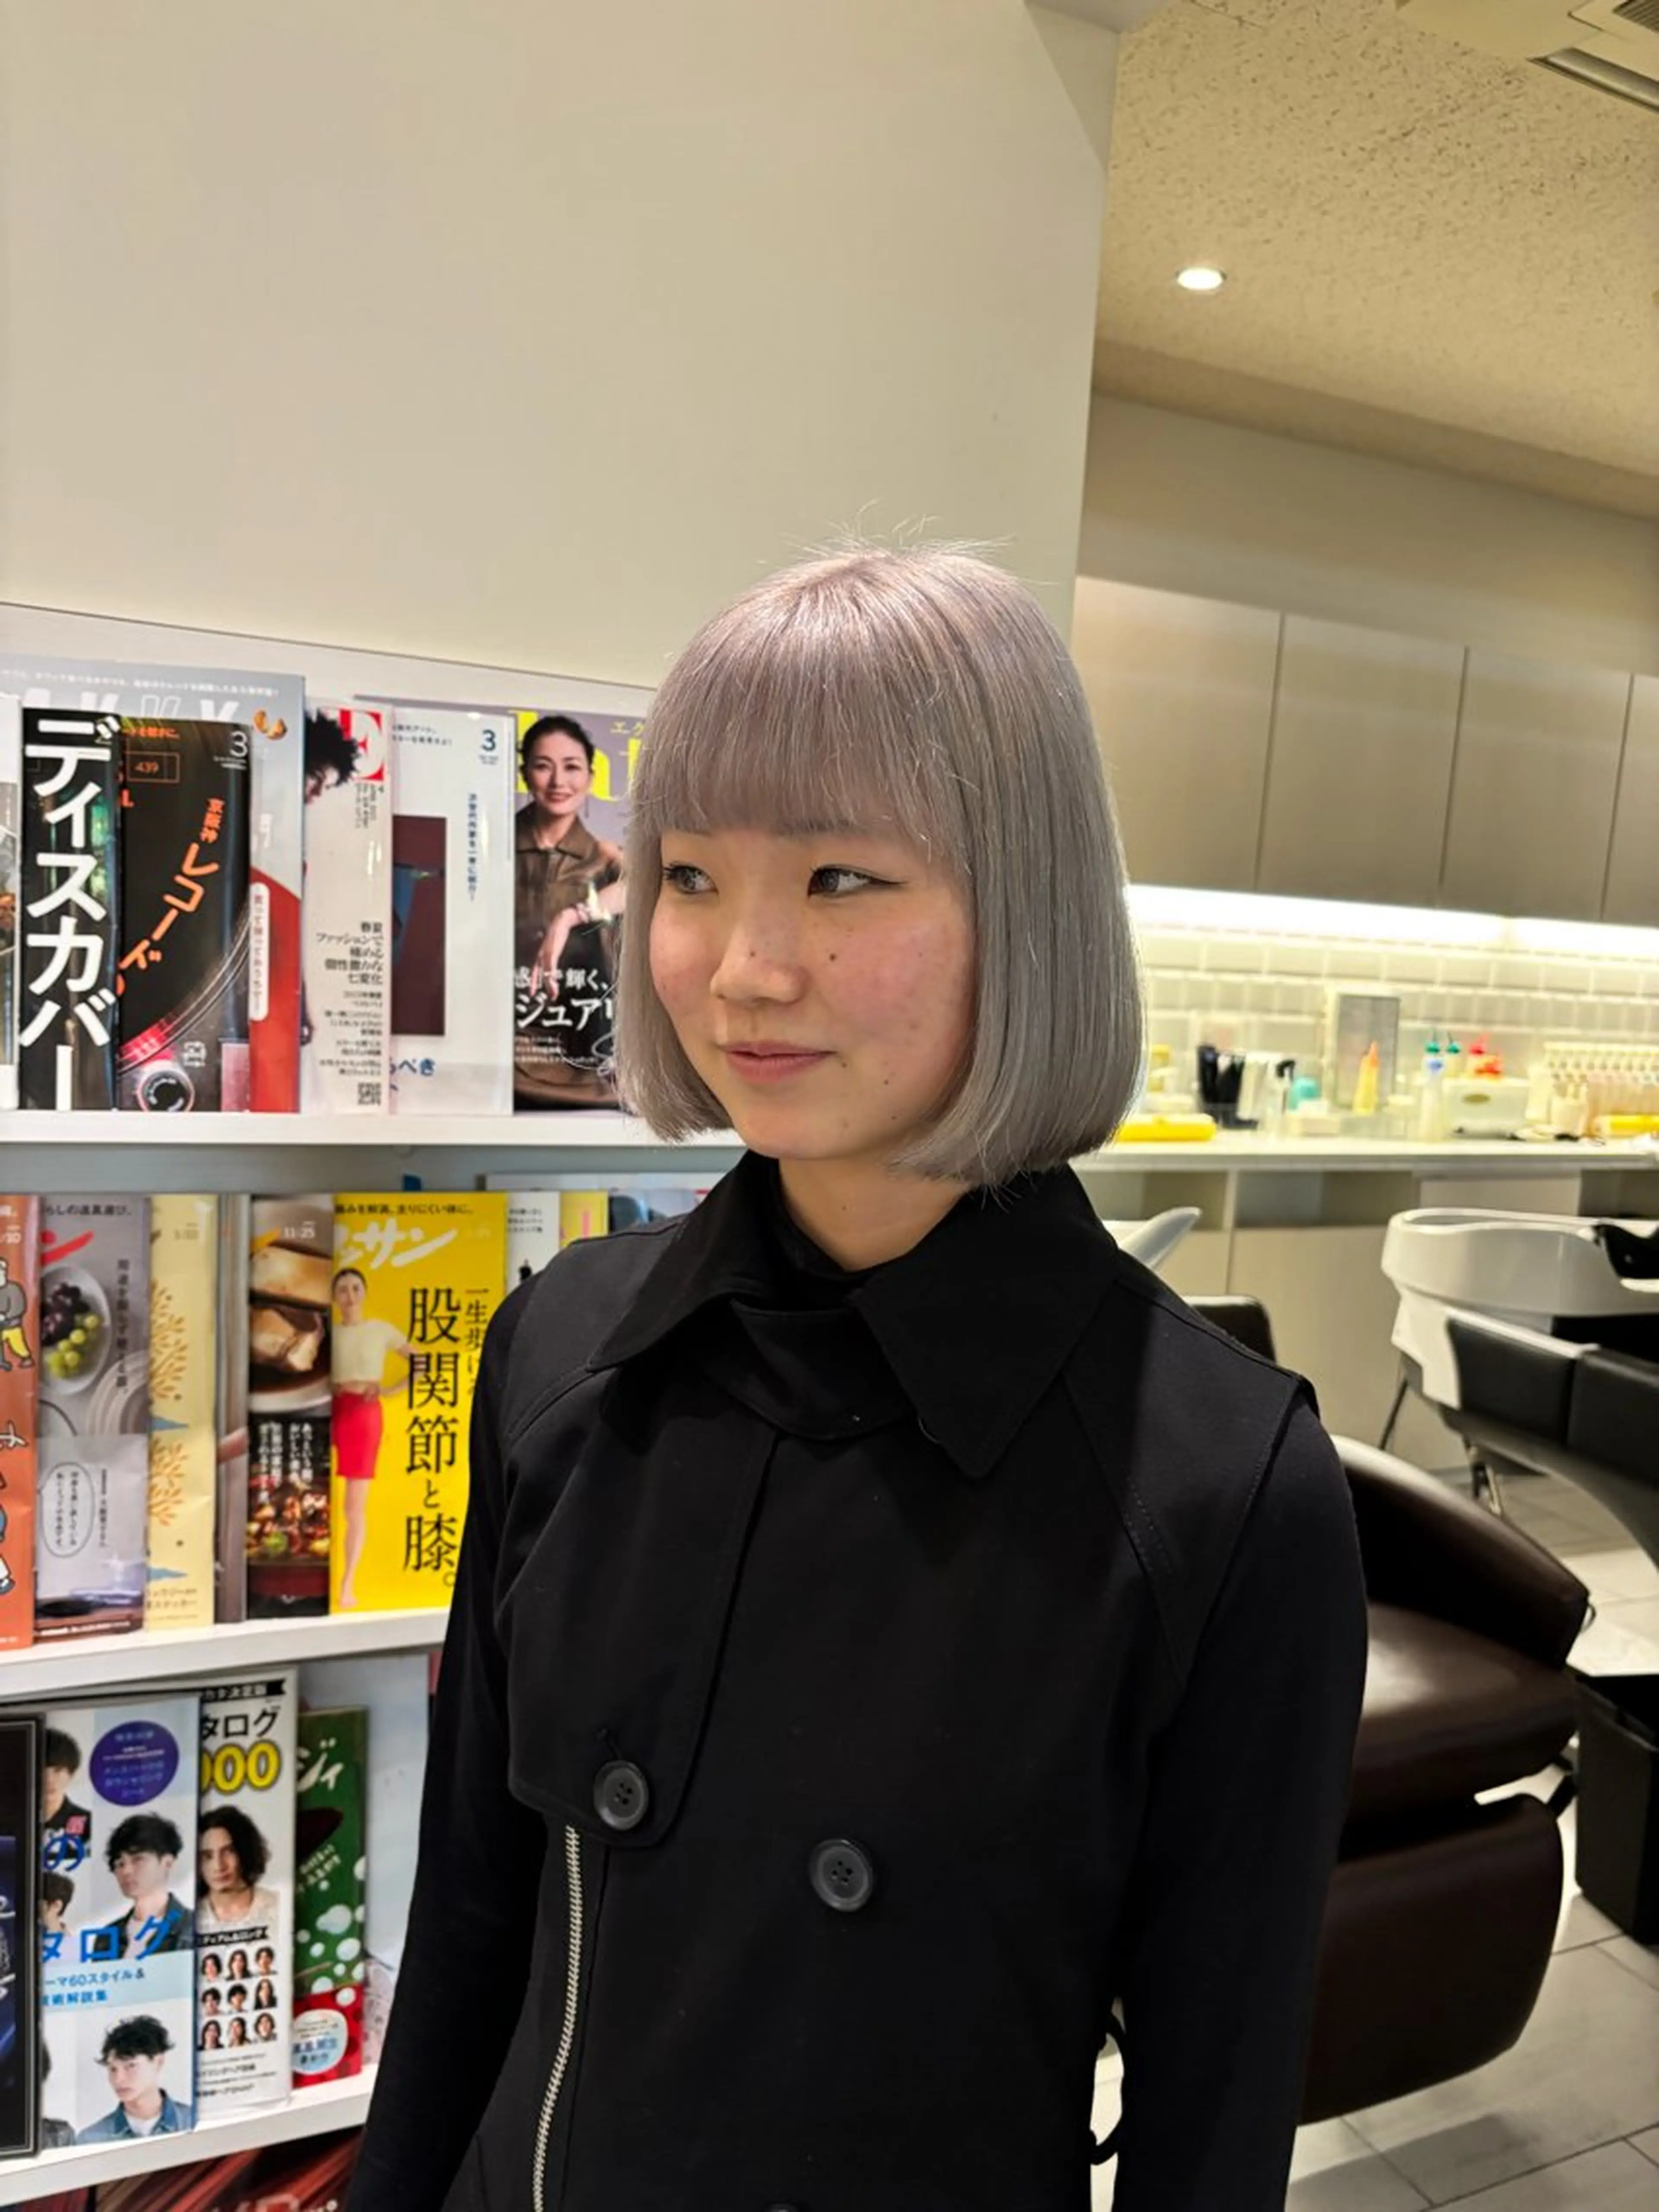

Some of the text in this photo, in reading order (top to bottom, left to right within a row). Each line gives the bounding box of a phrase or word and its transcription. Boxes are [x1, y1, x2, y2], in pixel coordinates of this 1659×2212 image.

[229, 731, 248, 757] 3
[482, 729, 496, 751] 3
[19, 716, 120, 1112] ディスカバー
